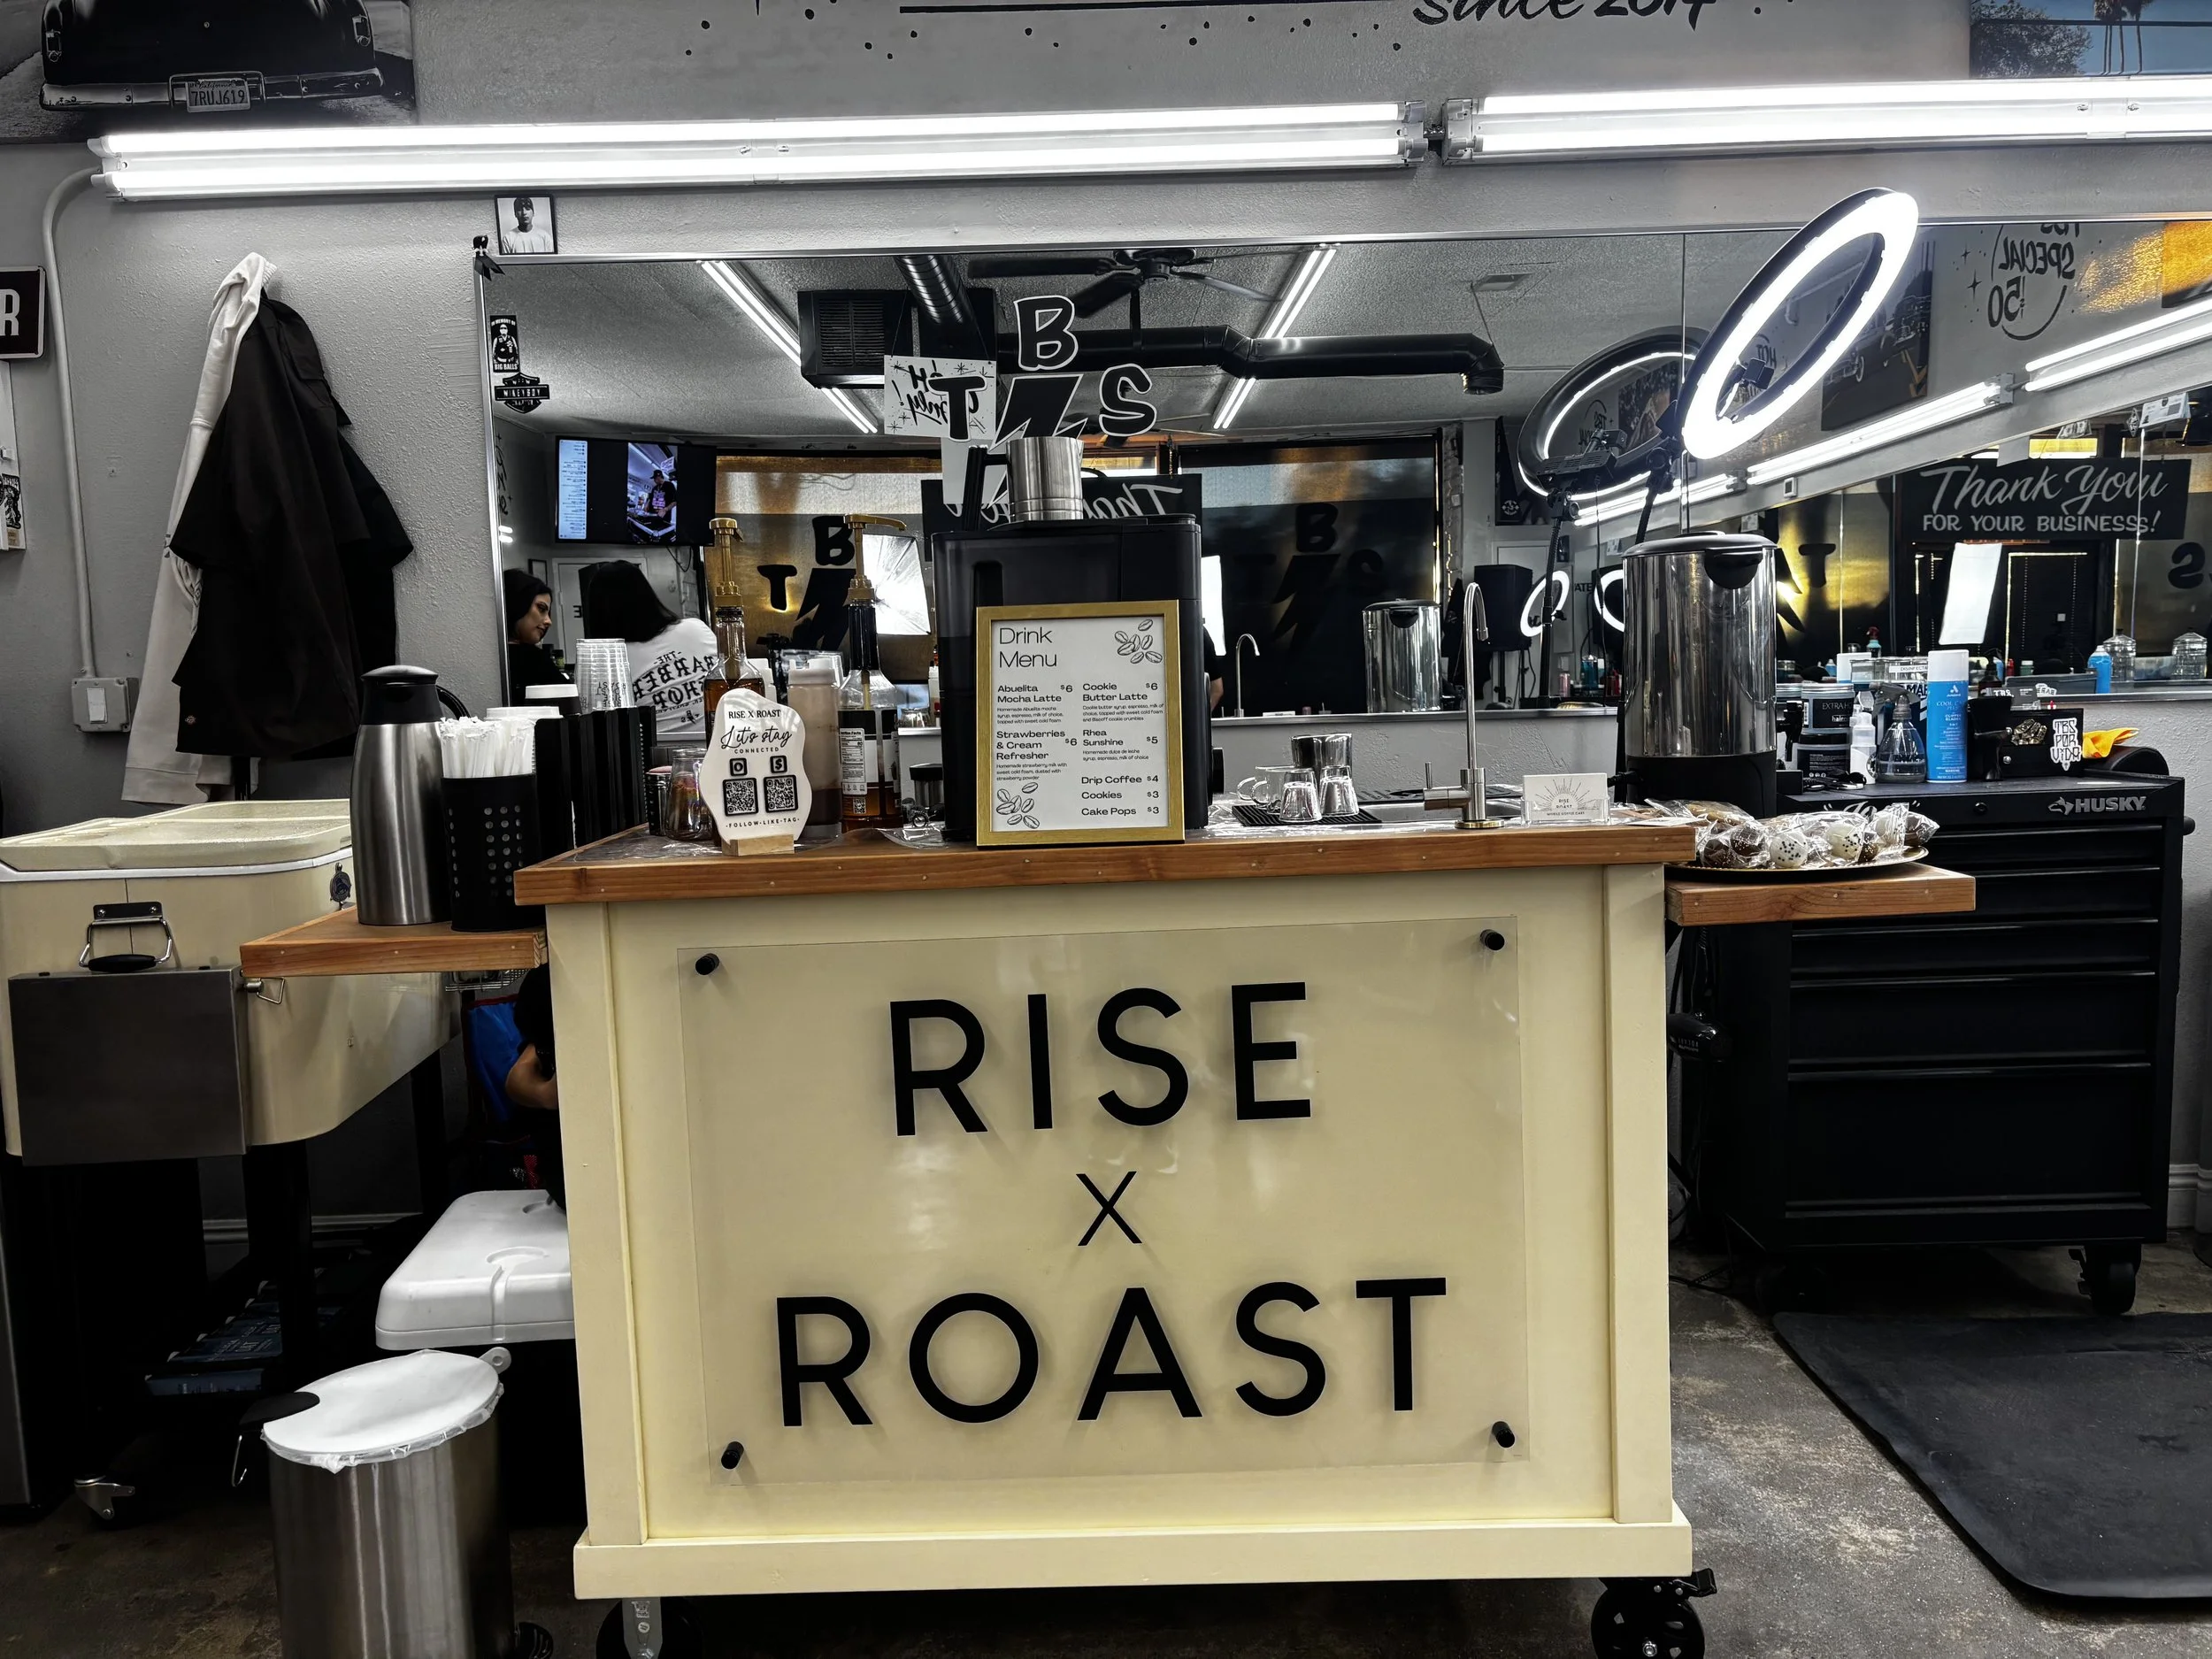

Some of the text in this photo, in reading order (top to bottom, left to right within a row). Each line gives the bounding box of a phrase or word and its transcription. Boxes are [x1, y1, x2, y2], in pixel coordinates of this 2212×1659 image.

[190, 89, 245, 106] 7RUJ619
[1919, 463, 2063, 515] Thank
[1924, 514, 1962, 531] FOR
[1970, 515, 2026, 532] YOUR
[1000, 626, 1053, 644] Drink
[999, 650, 1057, 668] Menu
[997, 684, 1039, 693] Abuelita
[728, 710, 746, 719] RISE
[757, 709, 781, 718] ROAST
[996, 730, 1066, 739] Strawberries
[2055, 720, 2076, 733] TBS
[720, 725, 793, 749] Let's stay
[2055, 734, 2077, 747] POR
[1081, 776, 1103, 786] Drip
[1104, 775, 1142, 784] Coffee
[1081, 790, 1123, 799] Cookies
[1110, 807, 1137, 817] Pops
[2075, 796, 2147, 812] HUSKY
[889, 981, 1311, 1137] RISE
[1075, 1171, 1143, 1247] X
[777, 1277, 1447, 1426] ROAST
